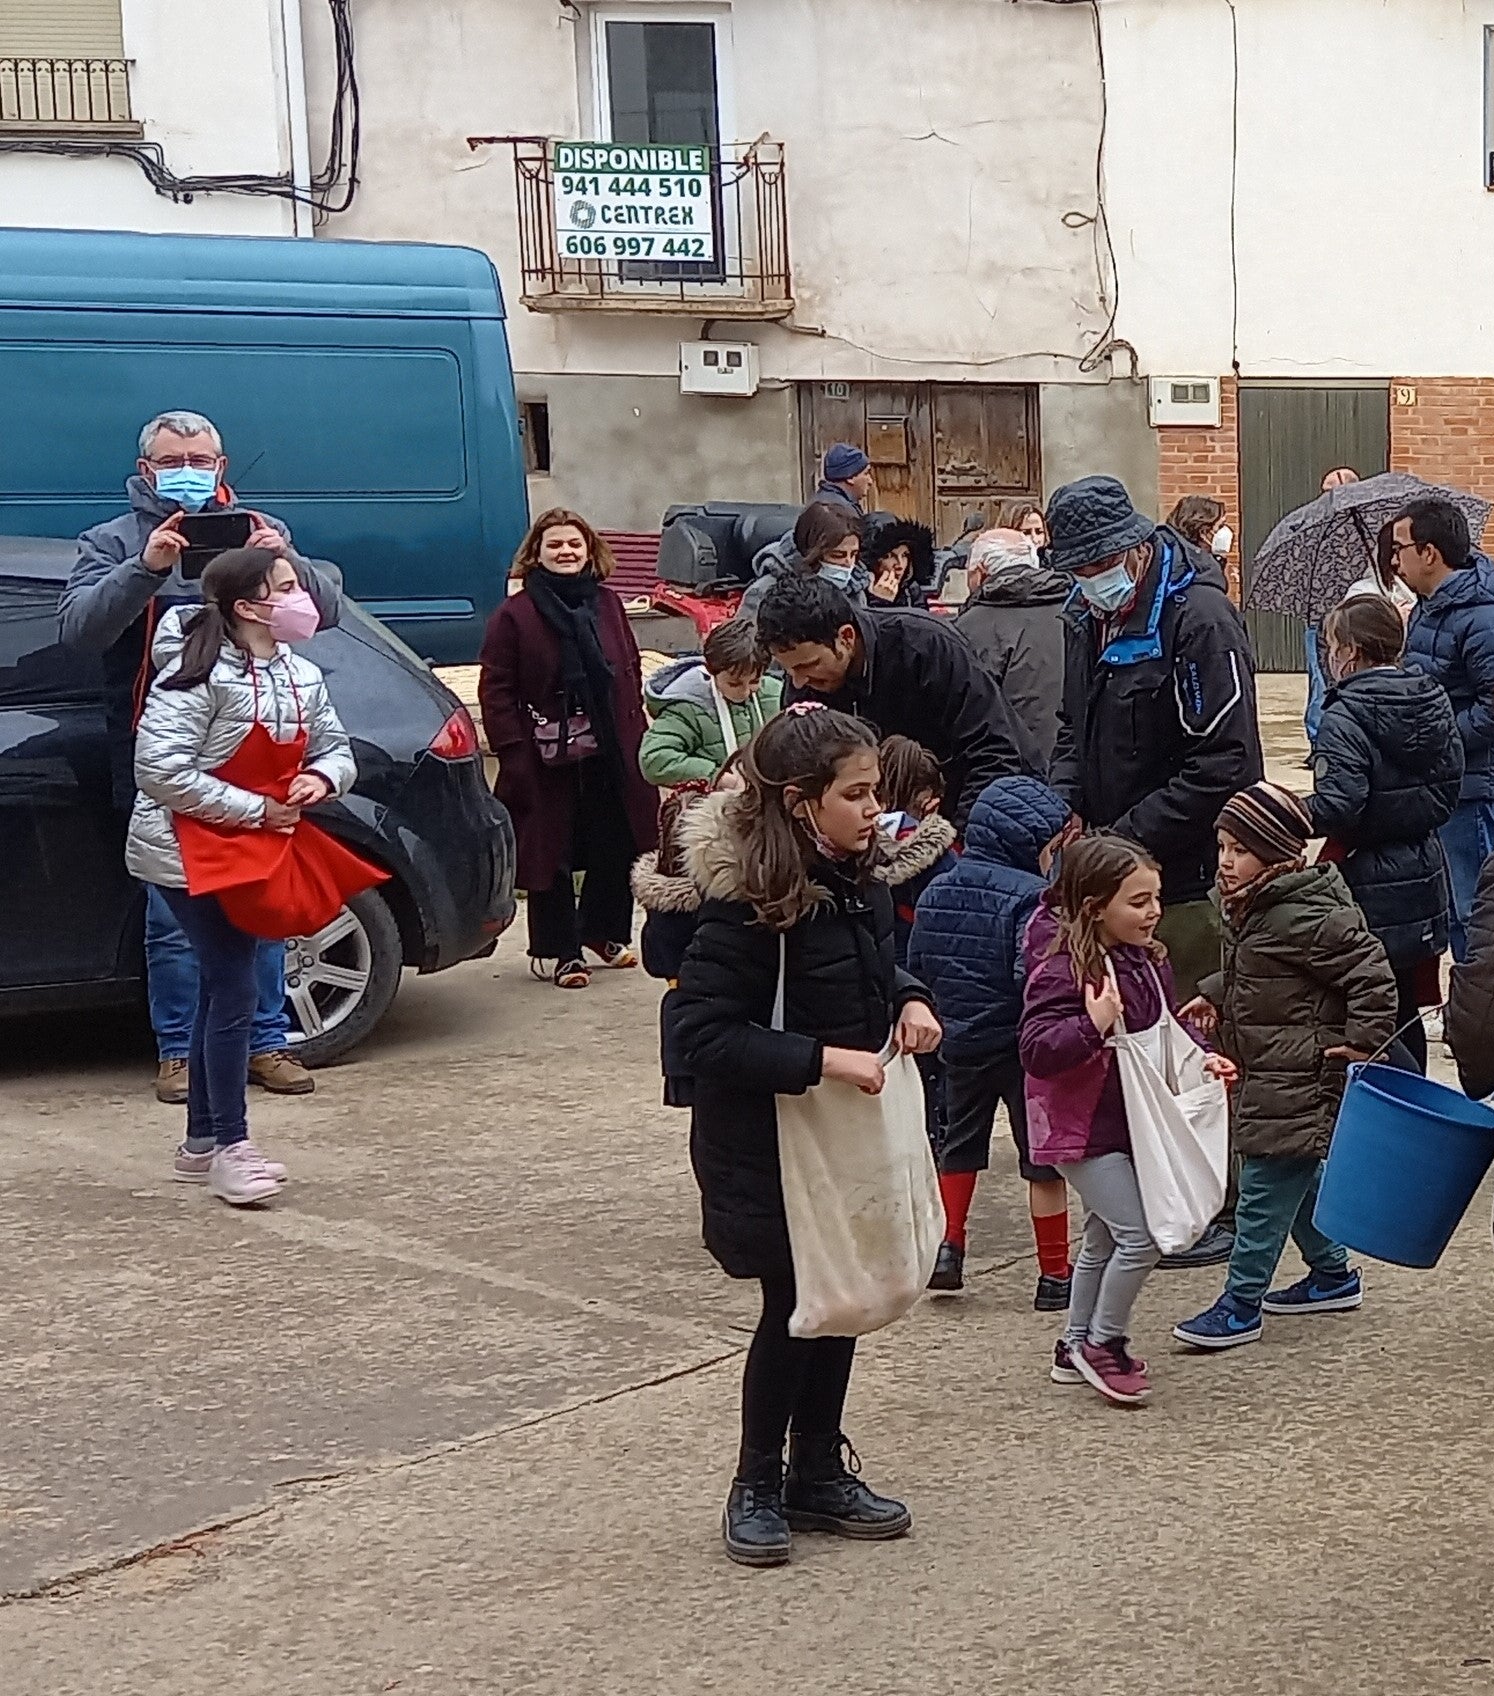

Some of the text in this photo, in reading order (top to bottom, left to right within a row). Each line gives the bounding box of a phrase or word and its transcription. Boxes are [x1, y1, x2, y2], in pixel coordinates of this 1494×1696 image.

[559, 148, 703, 171] DISPONIBLE
[562, 175, 702, 197] 941 444 510
[601, 204, 694, 225] CENTREX
[566, 235, 705, 257] 606 997 442
[1400, 389, 1410, 404] 9
